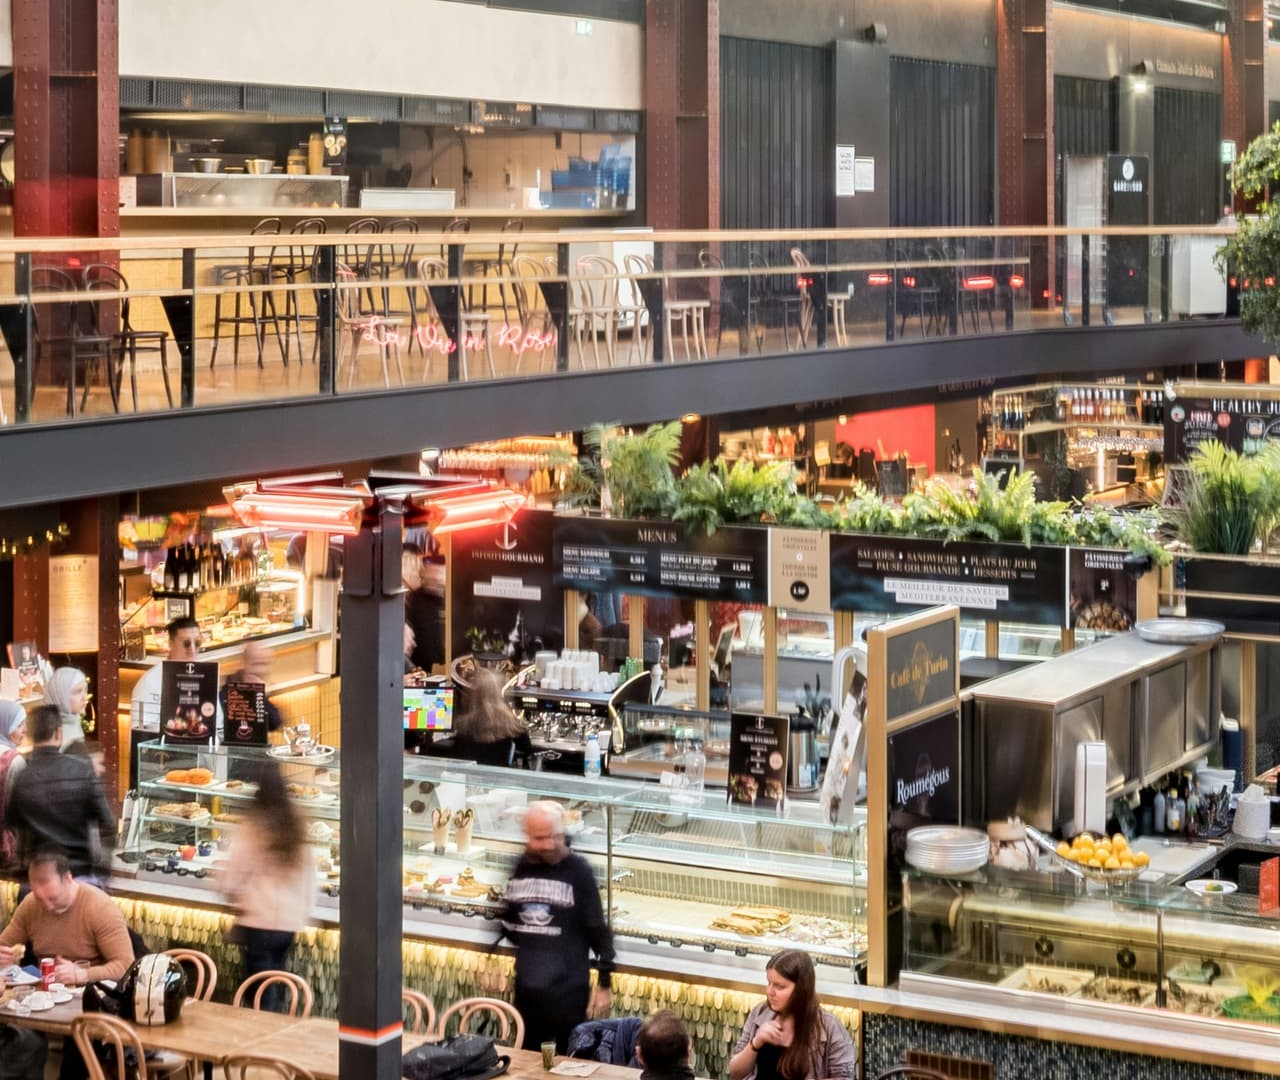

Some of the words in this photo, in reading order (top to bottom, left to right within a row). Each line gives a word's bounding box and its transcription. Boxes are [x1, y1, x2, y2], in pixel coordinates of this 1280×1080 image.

[1212, 398, 1262, 414] HEALTHY
[637, 528, 677, 544] MENUS
[857, 549, 895, 561] SALADES
[907, 552, 958, 565] SANDWICHS
[970, 556, 996, 567] PLATS
[904, 563, 961, 577] GOURMANDE
[973, 568, 1018, 580] DESSERTS
[890, 666, 911, 690] Café
[911, 664, 922, 683] de
[896, 765, 951, 806] Roumégous
